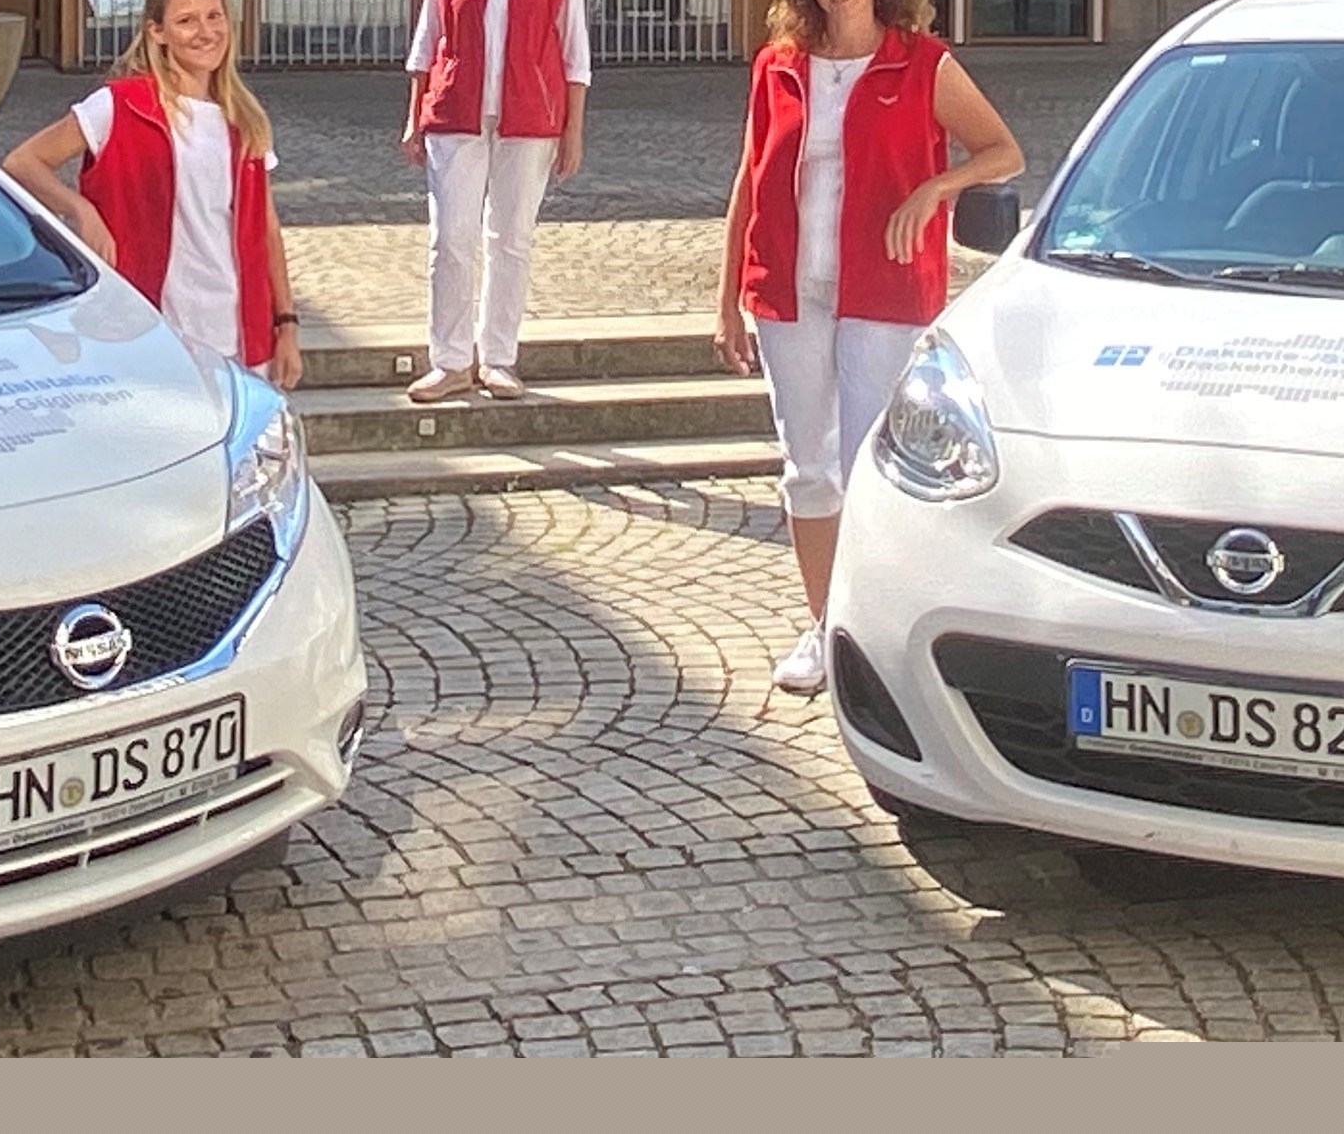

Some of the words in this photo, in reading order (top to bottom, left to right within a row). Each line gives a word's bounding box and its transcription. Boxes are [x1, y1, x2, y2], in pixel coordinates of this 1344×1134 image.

[1106, 681, 1170, 736] HN
[1208, 693, 1276, 748] DS
[90, 737, 149, 802] DS
[162, 710, 236, 778] 870
